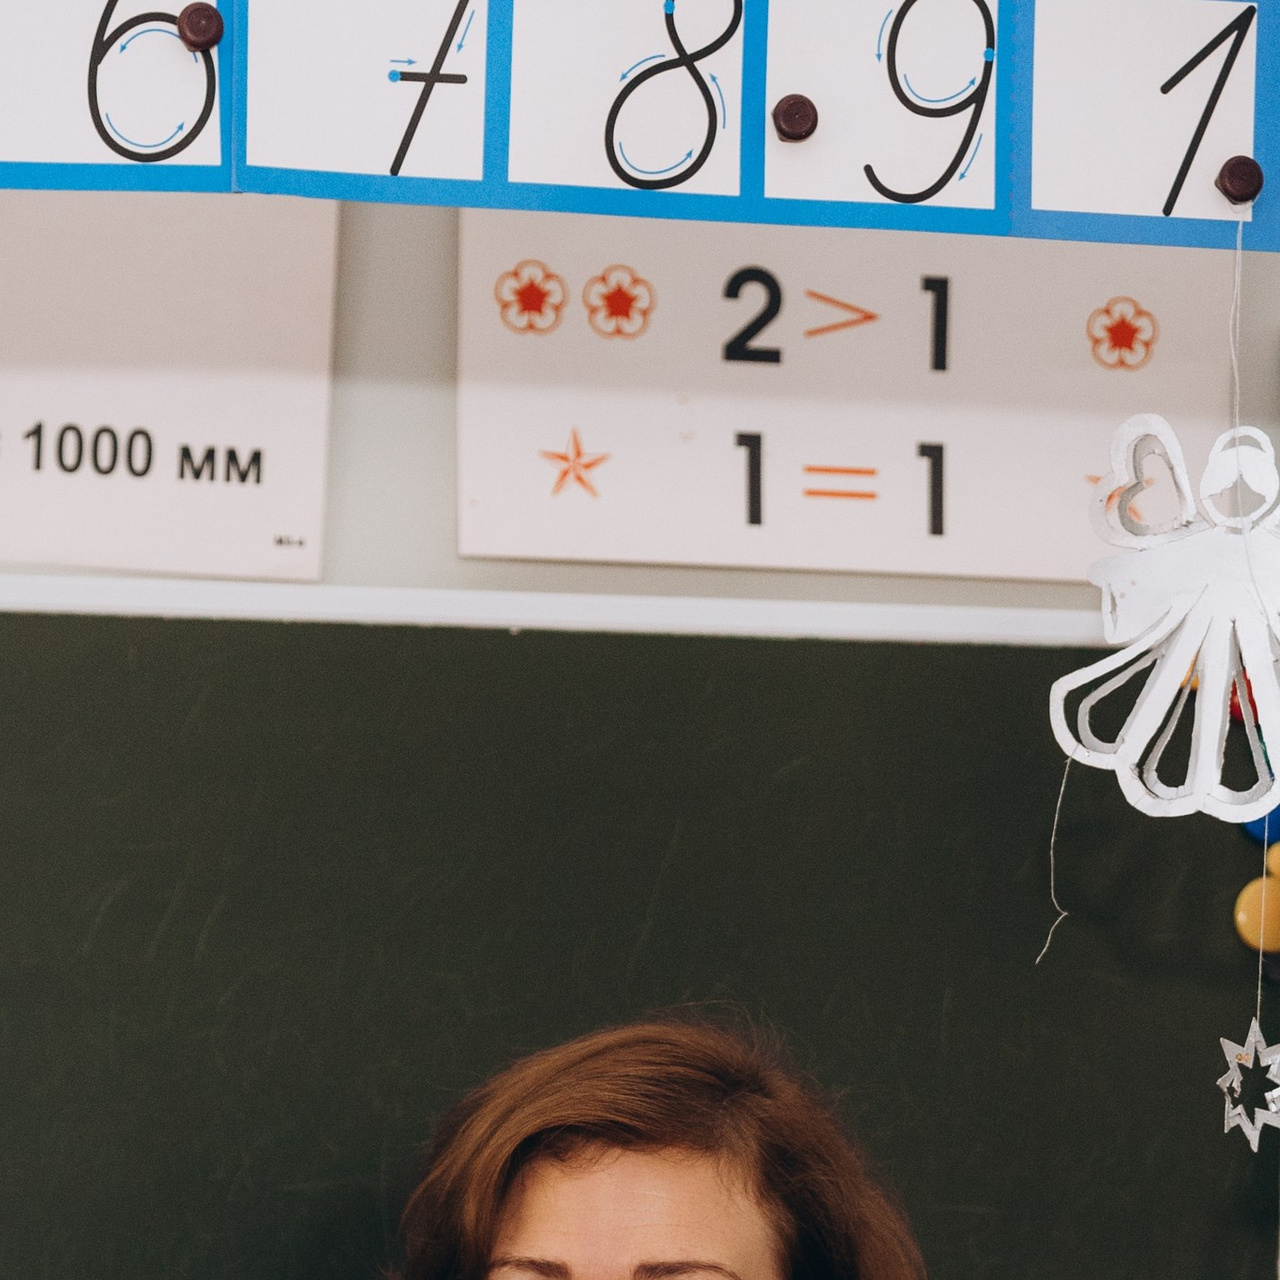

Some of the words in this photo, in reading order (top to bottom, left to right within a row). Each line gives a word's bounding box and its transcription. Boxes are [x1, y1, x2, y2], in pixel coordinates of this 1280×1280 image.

[87, 0, 216, 163] 6
[389, 0, 469, 177] 7
[604, 0, 743, 190] 8
[863, 0, 996, 204] 9
[1160, 5, 1257, 217] 1
[722, 265, 783, 365] 2
[920, 276, 950, 371] 1
[24, 421, 154, 478] 1000
[178, 444, 263, 485] мм
[735, 432, 762, 525] 1
[918, 442, 944, 536] 1
